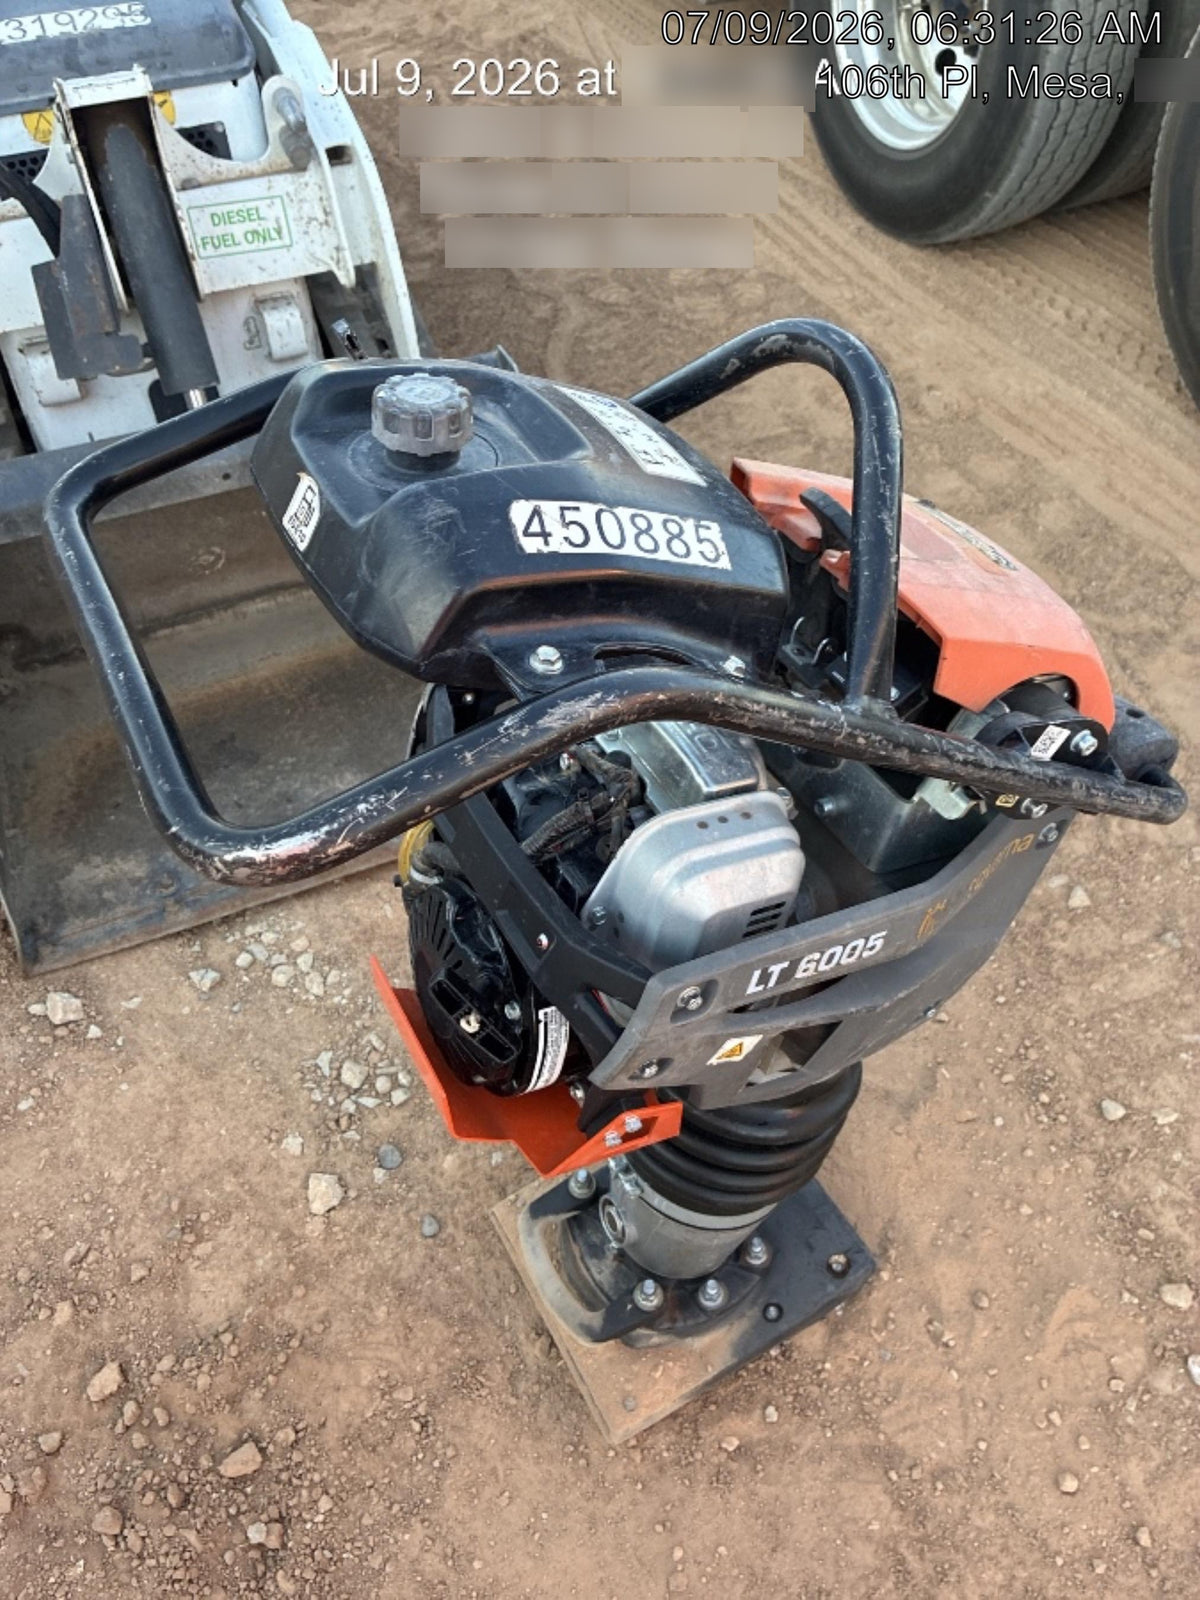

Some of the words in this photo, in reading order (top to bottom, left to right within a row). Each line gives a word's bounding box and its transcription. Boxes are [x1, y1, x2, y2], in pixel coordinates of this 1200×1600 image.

[201, 232, 241, 250] FUEL
[244, 220, 283, 246] ONLY
[210, 206, 267, 227] DIESEL
[521, 503, 713, 564] 450885
[745, 961, 790, 996] LT
[794, 930, 888, 979] 6005
